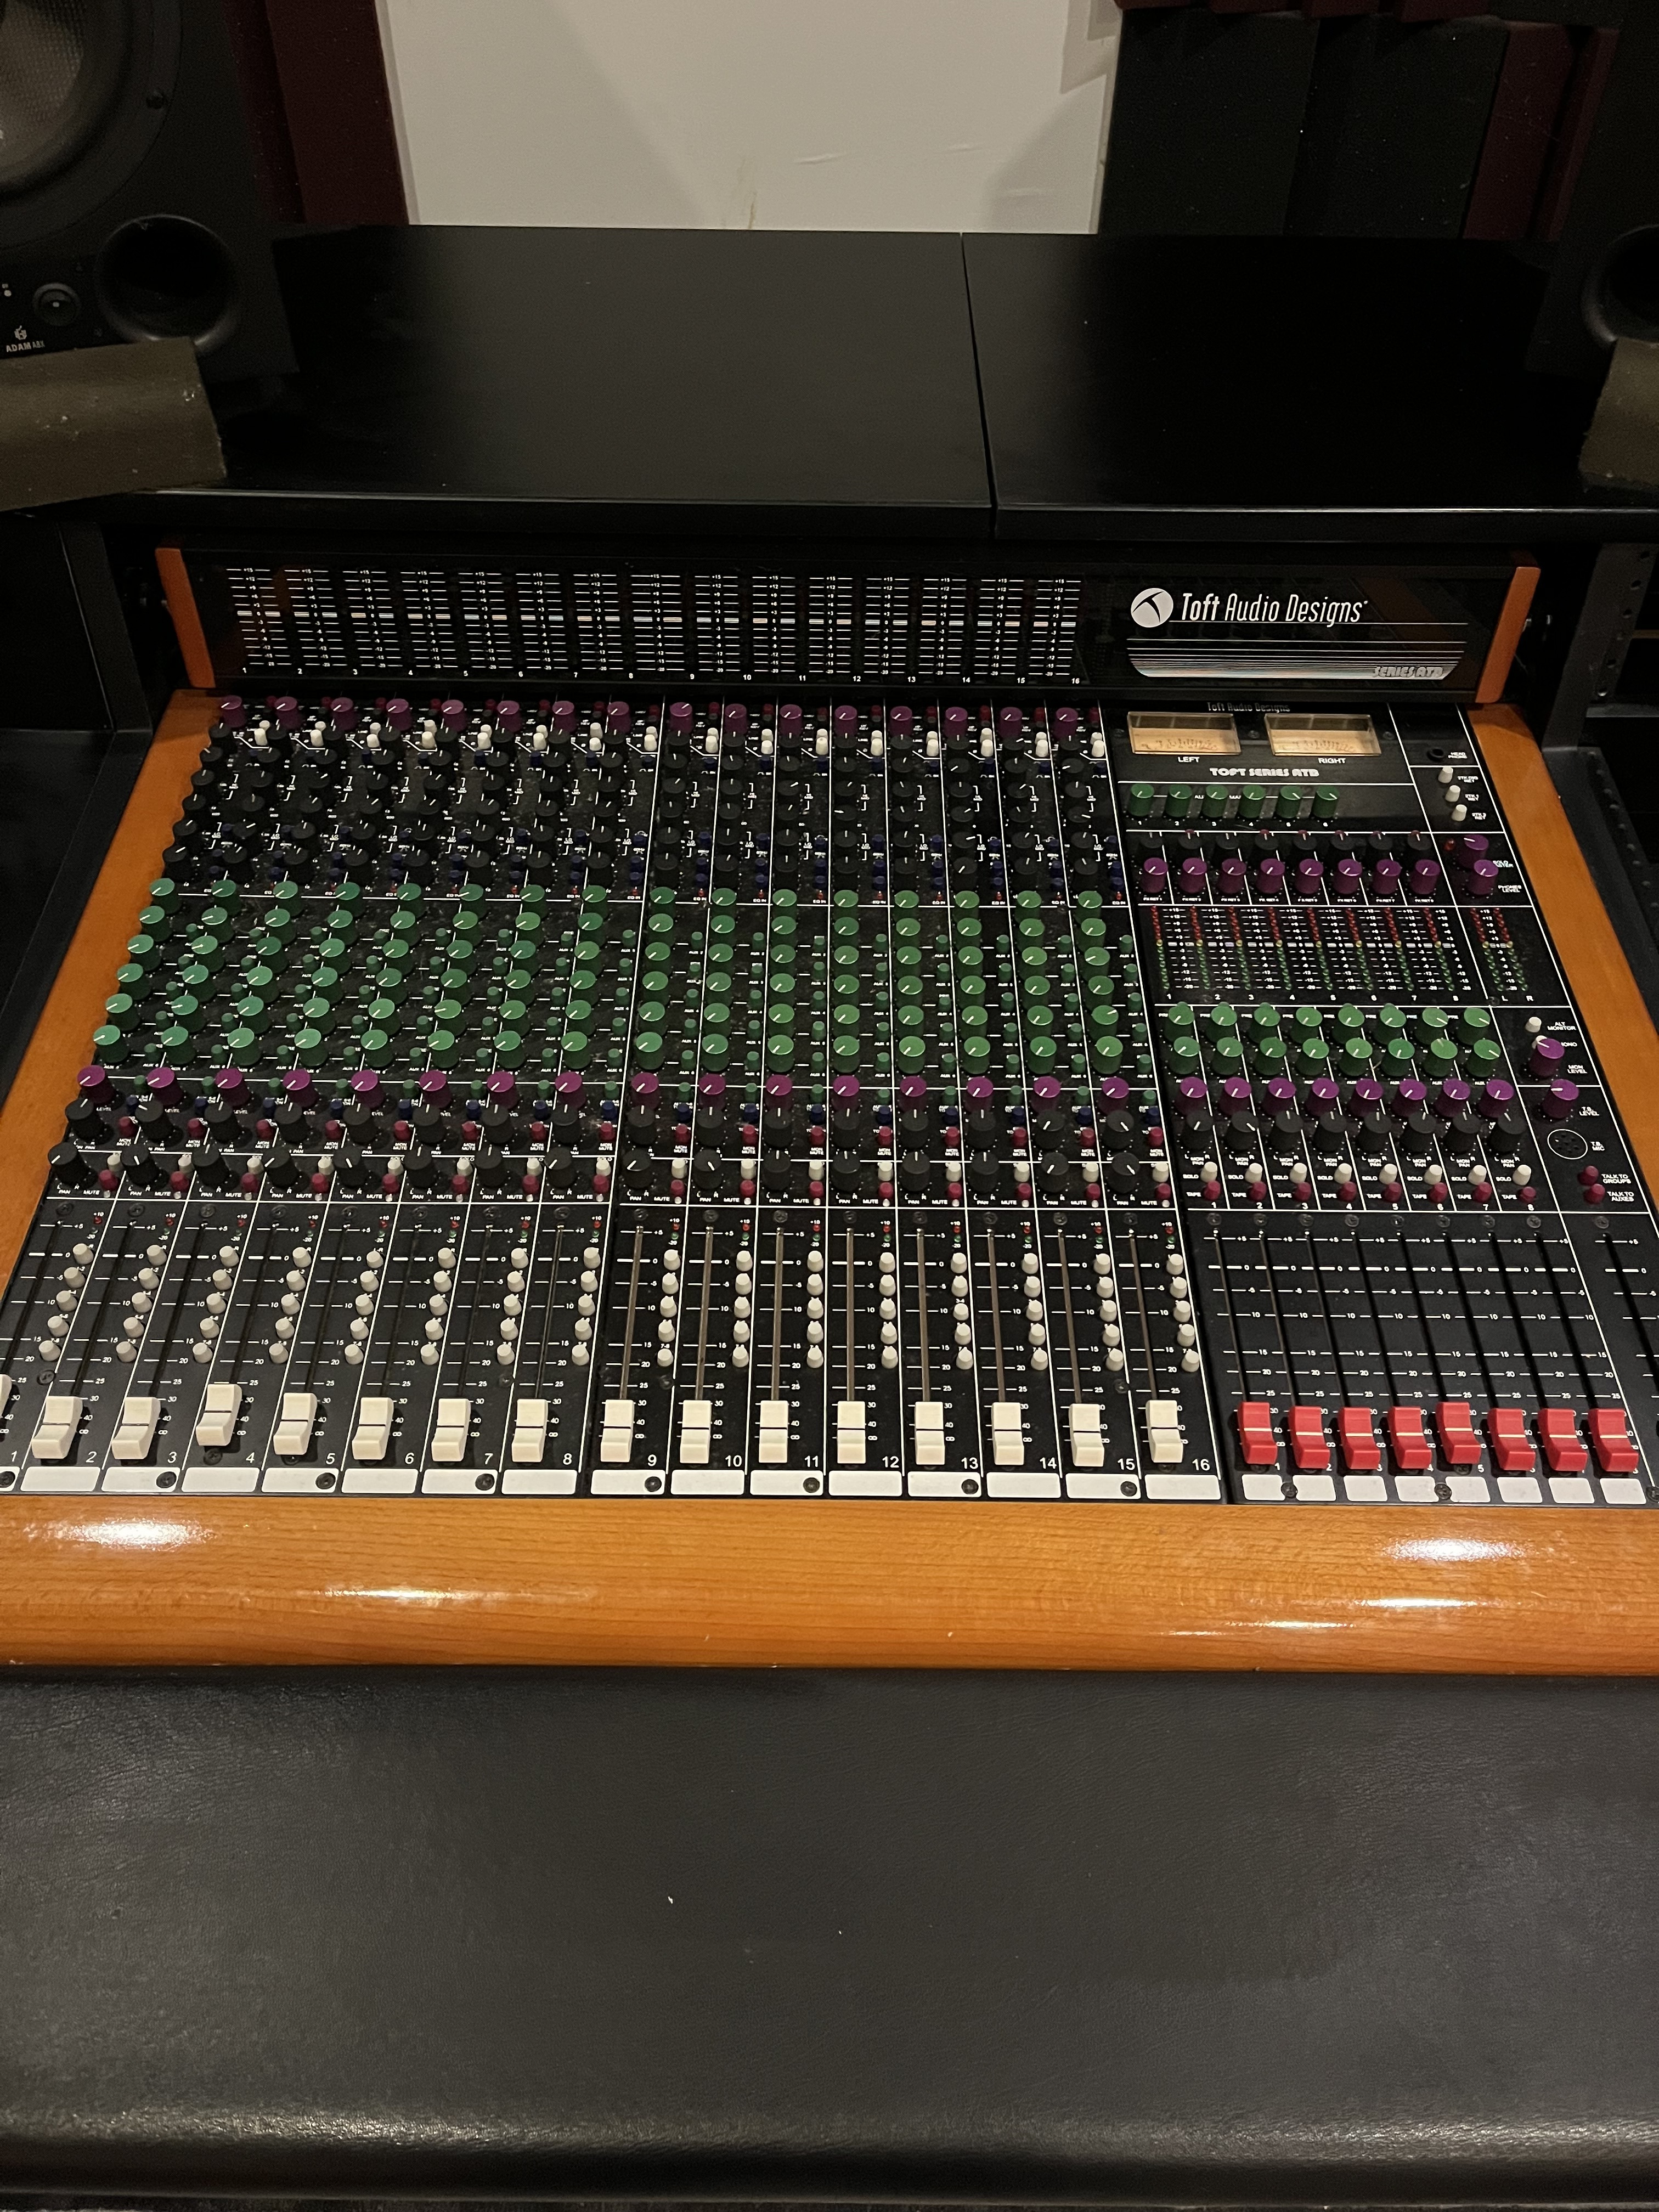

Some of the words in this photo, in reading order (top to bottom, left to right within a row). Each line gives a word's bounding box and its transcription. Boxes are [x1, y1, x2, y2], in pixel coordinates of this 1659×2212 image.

[6, 342, 31, 352] ADAM
[1182, 593, 1220, 620] Toft
[1225, 594, 1279, 622] Audio
[1284, 594, 1364, 627] Designs
[1207, 702, 1224, 711] Toft
[1228, 703, 1252, 712] Audio
[1255, 703, 1290, 713] Designs
[12, 1451, 17, 1462] 1
[86, 1452, 97, 1463] 2
[168, 1452, 177, 1463] 3
[246, 1452, 254, 1463] 4
[326, 1453, 335, 1464] 5
[405, 1453, 414, 1464] 6
[485, 1453, 493, 1464] 7
[563, 1453, 572, 1465] 8
[648, 1454, 657, 1466] 9
[725, 1455, 742, 1466] 10
[805, 1455, 818, 1467] 11
[883, 1456, 899, 1468] 12
[962, 1458, 978, 1469] 13
[1040, 1458, 1057, 1469] 14
[1118, 1459, 1135, 1470] 15
[1193, 1459, 1210, 1470] 16
